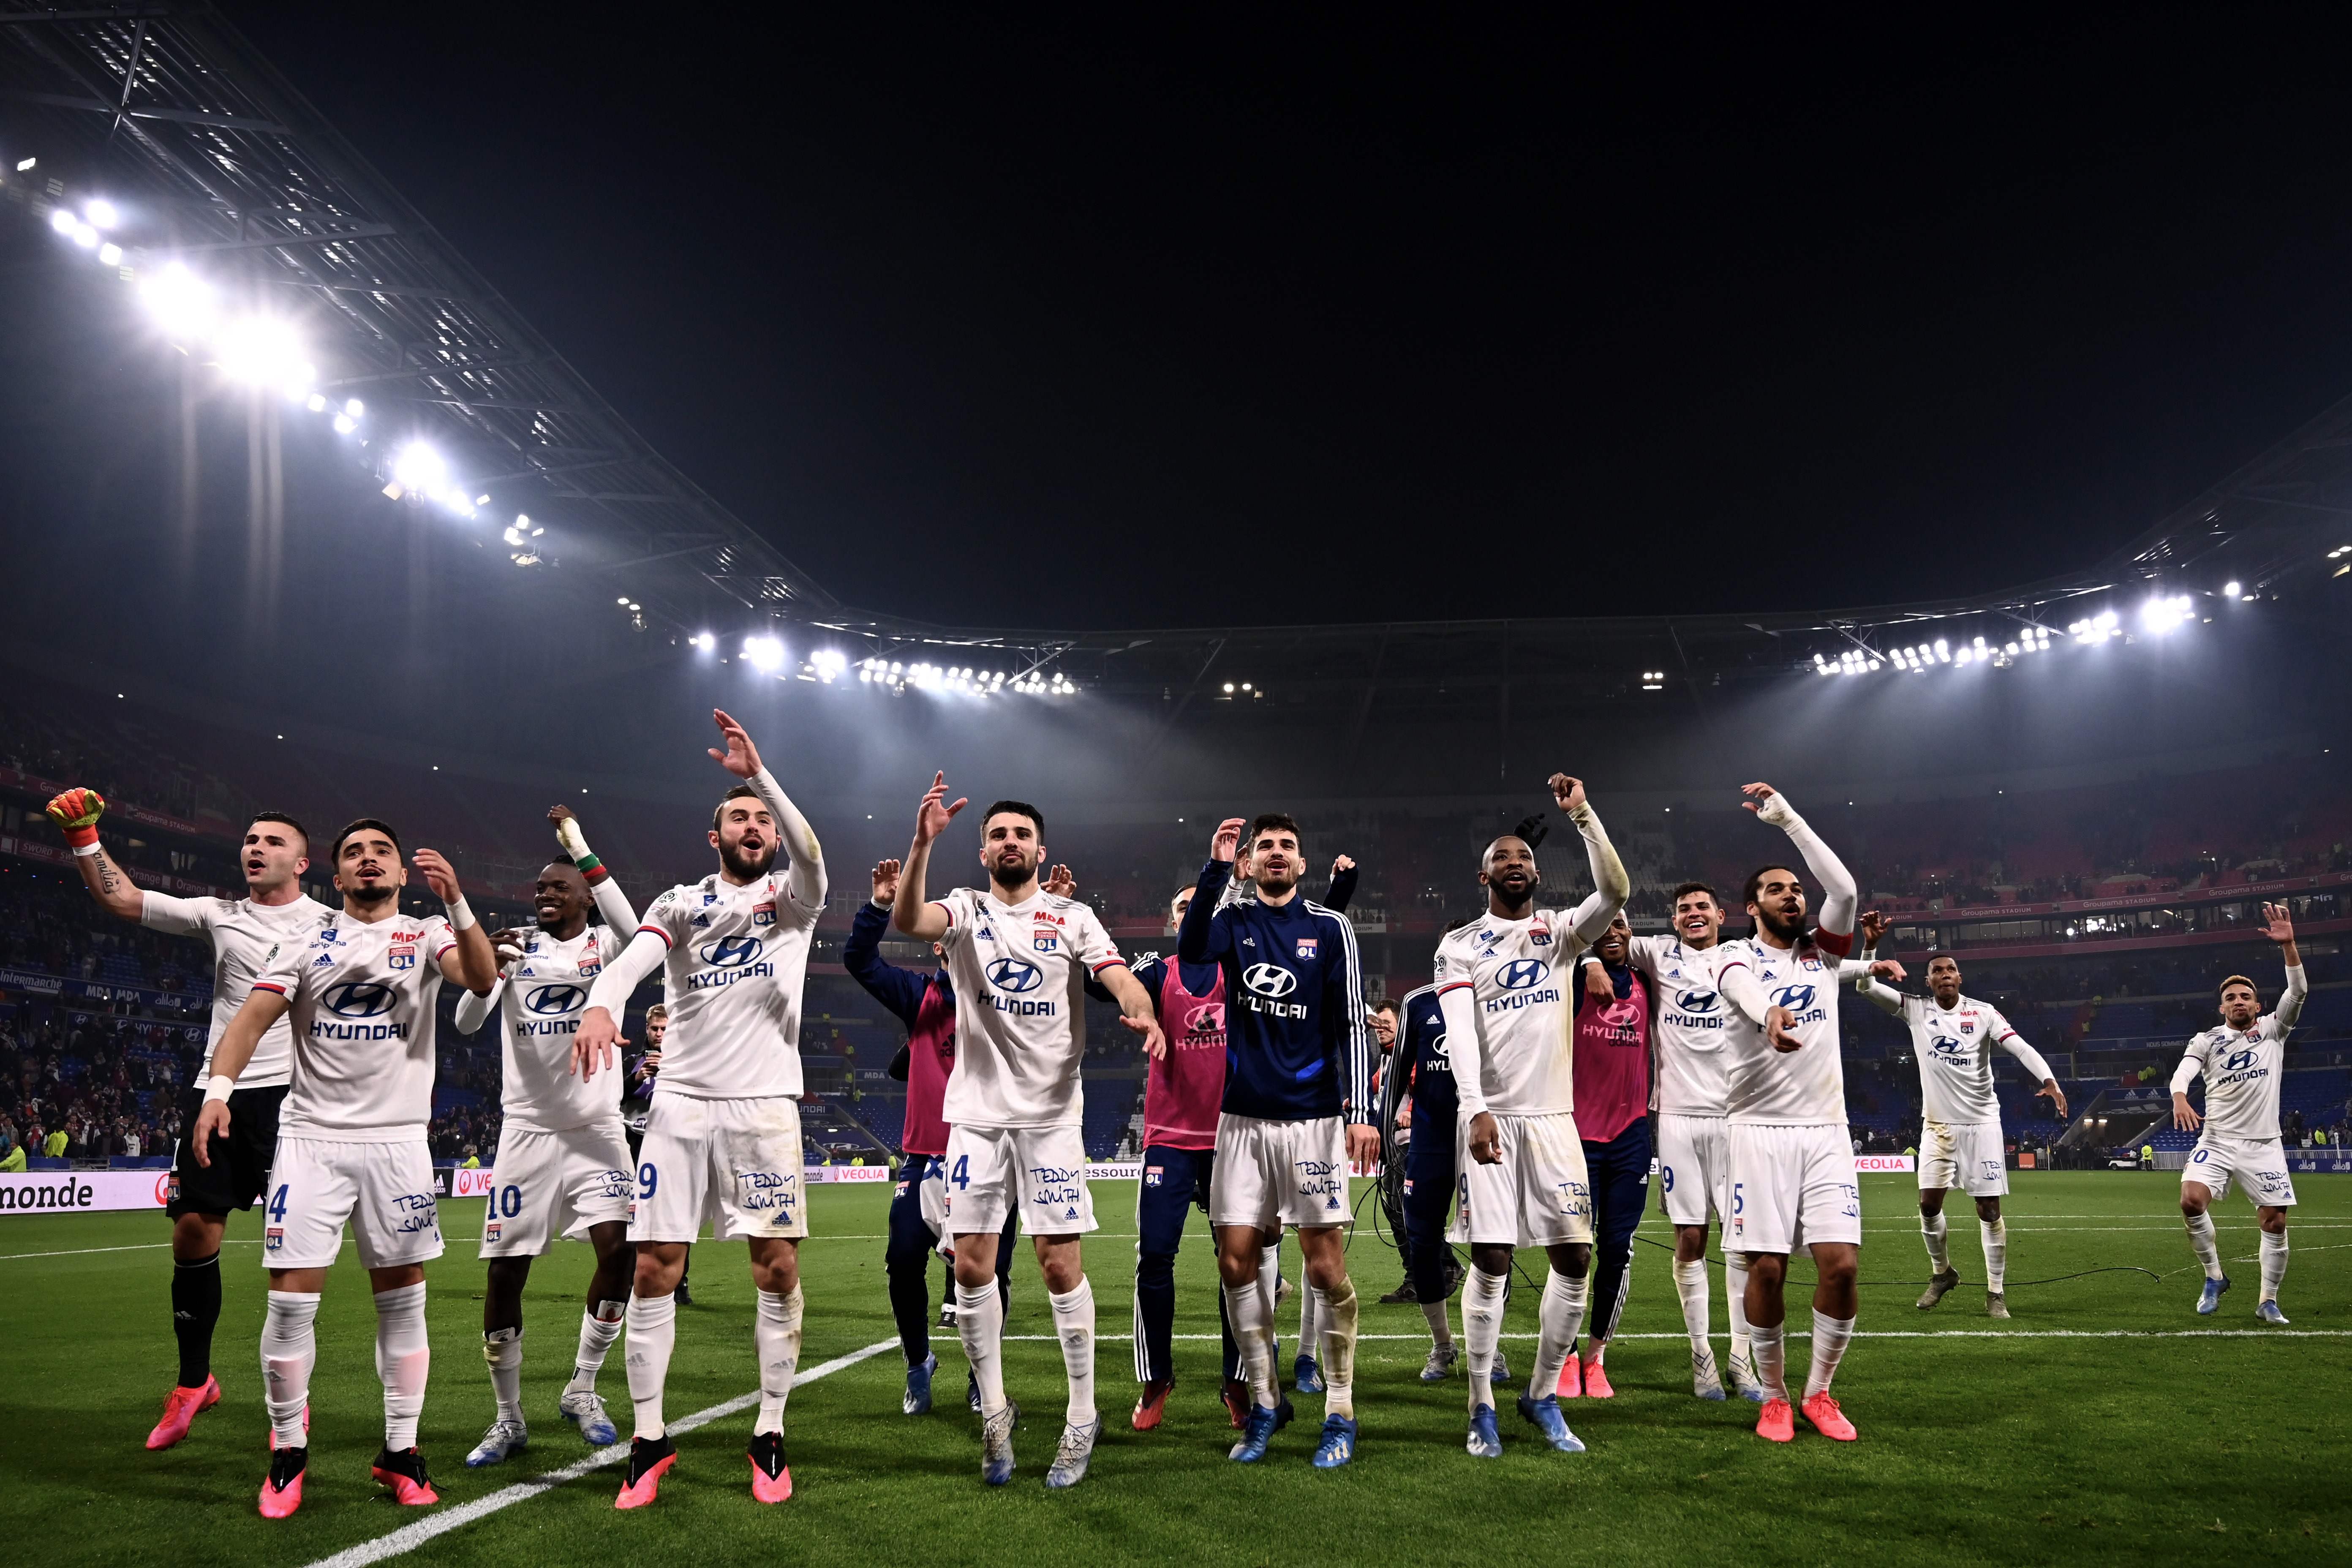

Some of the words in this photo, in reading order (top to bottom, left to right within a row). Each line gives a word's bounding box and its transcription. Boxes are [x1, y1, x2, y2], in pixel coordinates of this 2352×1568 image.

[169, 822, 196, 833] STADIUM
[23, 843, 53, 856] SWORD
[92, 848, 117, 887] amilia
[128, 867, 161, 885] Orange
[176, 879, 206, 895] Orange
[2208, 887, 2250, 896] Groupama
[2252, 883, 2284, 892] STADIUM
[2082, 900, 2123, 909] Groupama
[1033, 911, 1066, 926] MDA
[1961, 909, 1999, 917] Groupama
[391, 930, 425, 943] MDA
[1473, 935, 1504, 950] Groupama
[0, 970, 63, 990] Intermarché
[688, 963, 773, 989] HYUNDAI
[86, 985, 111, 998] MDA
[116, 989, 140, 1003] MDA
[1238, 991, 1307, 1020] HYUNDAI
[1486, 989, 1560, 1013] HYUNDAI
[517, 1020, 580, 1037] HYUND
[1664, 1013, 1723, 1029] HYUNDA
[309, 1020, 407, 1040] HYUNDAI
[1175, 1032, 1227, 1051] HYUN
[864, 1071, 885, 1079] MDA
[2218, 1067, 2268, 1085] HYUNDAI
[798, 1105, 825, 1113] UNDAI
[1085, 1167, 1141, 1178] essour
[1295, 1161, 1341, 1177] TEDDY
[2298, 1160, 2311, 1170] alila
[2332, 1160, 2345, 1170] alila
[596, 1170, 634, 1185] TEDD
[738, 1172, 795, 1190] TEDDY
[804, 1168, 823, 1182] monde
[841, 1168, 885, 1179] VEOLIA
[1030, 1167, 1080, 1184] TEDDY
[434, 1186, 446, 1194] didas
[268, 1184, 289, 1223] 4
[392, 1192, 436, 1212] TEDD
[487, 1184, 522, 1221] 10
[1734, 1183, 1743, 1214] 5
